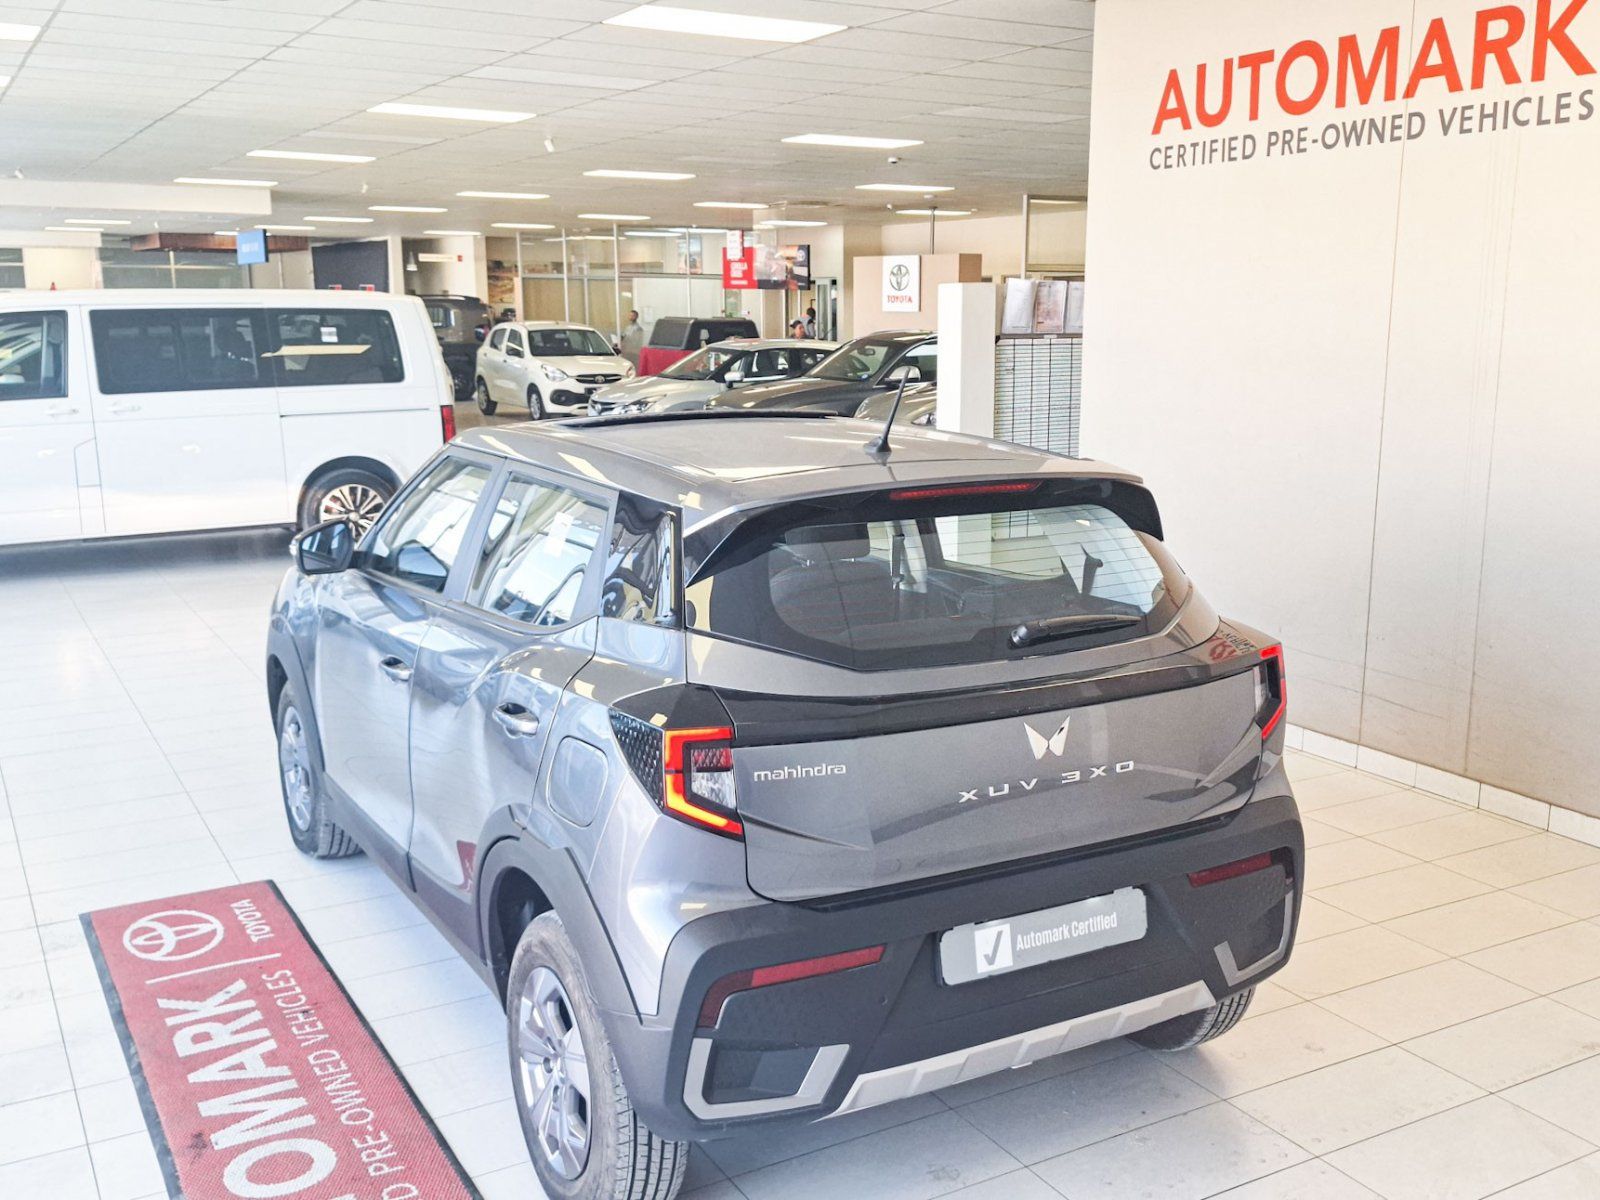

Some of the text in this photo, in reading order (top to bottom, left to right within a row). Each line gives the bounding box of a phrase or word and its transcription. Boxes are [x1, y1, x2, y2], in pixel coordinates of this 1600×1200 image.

[1151, 0, 1597, 136] AUTOMARK
[1149, 89, 1595, 170] CERTIFIED PRE-OWNED VEHICLES
[887, 295, 913, 304] TOYOTA
[754, 763, 846, 782] mahindra
[958, 777, 1039, 803] XUV
[230, 898, 275, 943] TOYOTA
[1016, 912, 1118, 951] Automark Certified
[261, 969, 329, 1047] VEHICLES
[157, 978, 356, 1200] OMARK
[307, 1049, 405, 1176] PRE-OWNED
